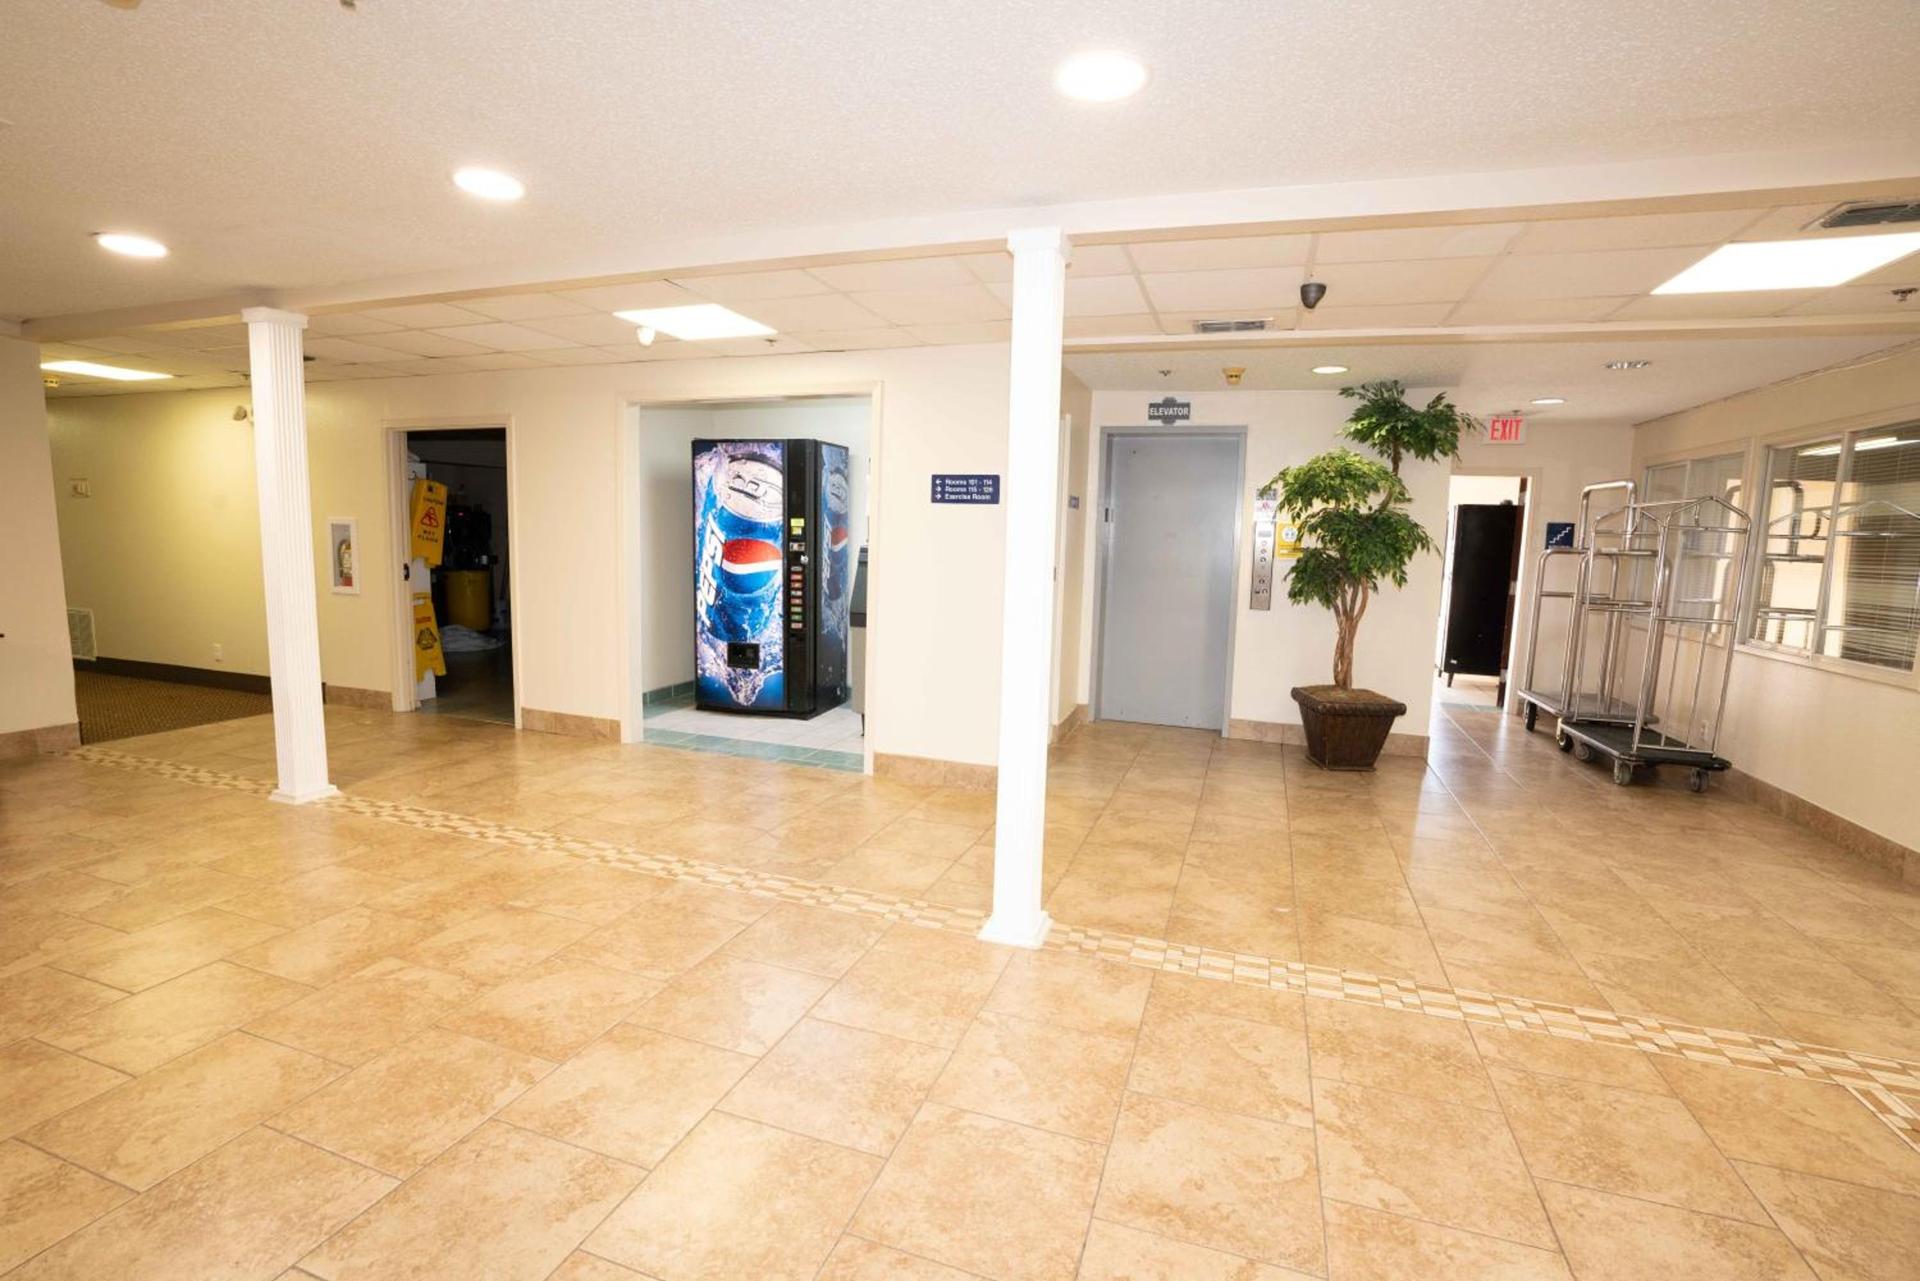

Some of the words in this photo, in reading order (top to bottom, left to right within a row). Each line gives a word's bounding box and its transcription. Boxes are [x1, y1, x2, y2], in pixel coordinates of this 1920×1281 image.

[1150, 407, 1189, 416] ELEVATOR
[1491, 419, 1522, 440] EXIT
[696, 512, 727, 629] PEPSI
